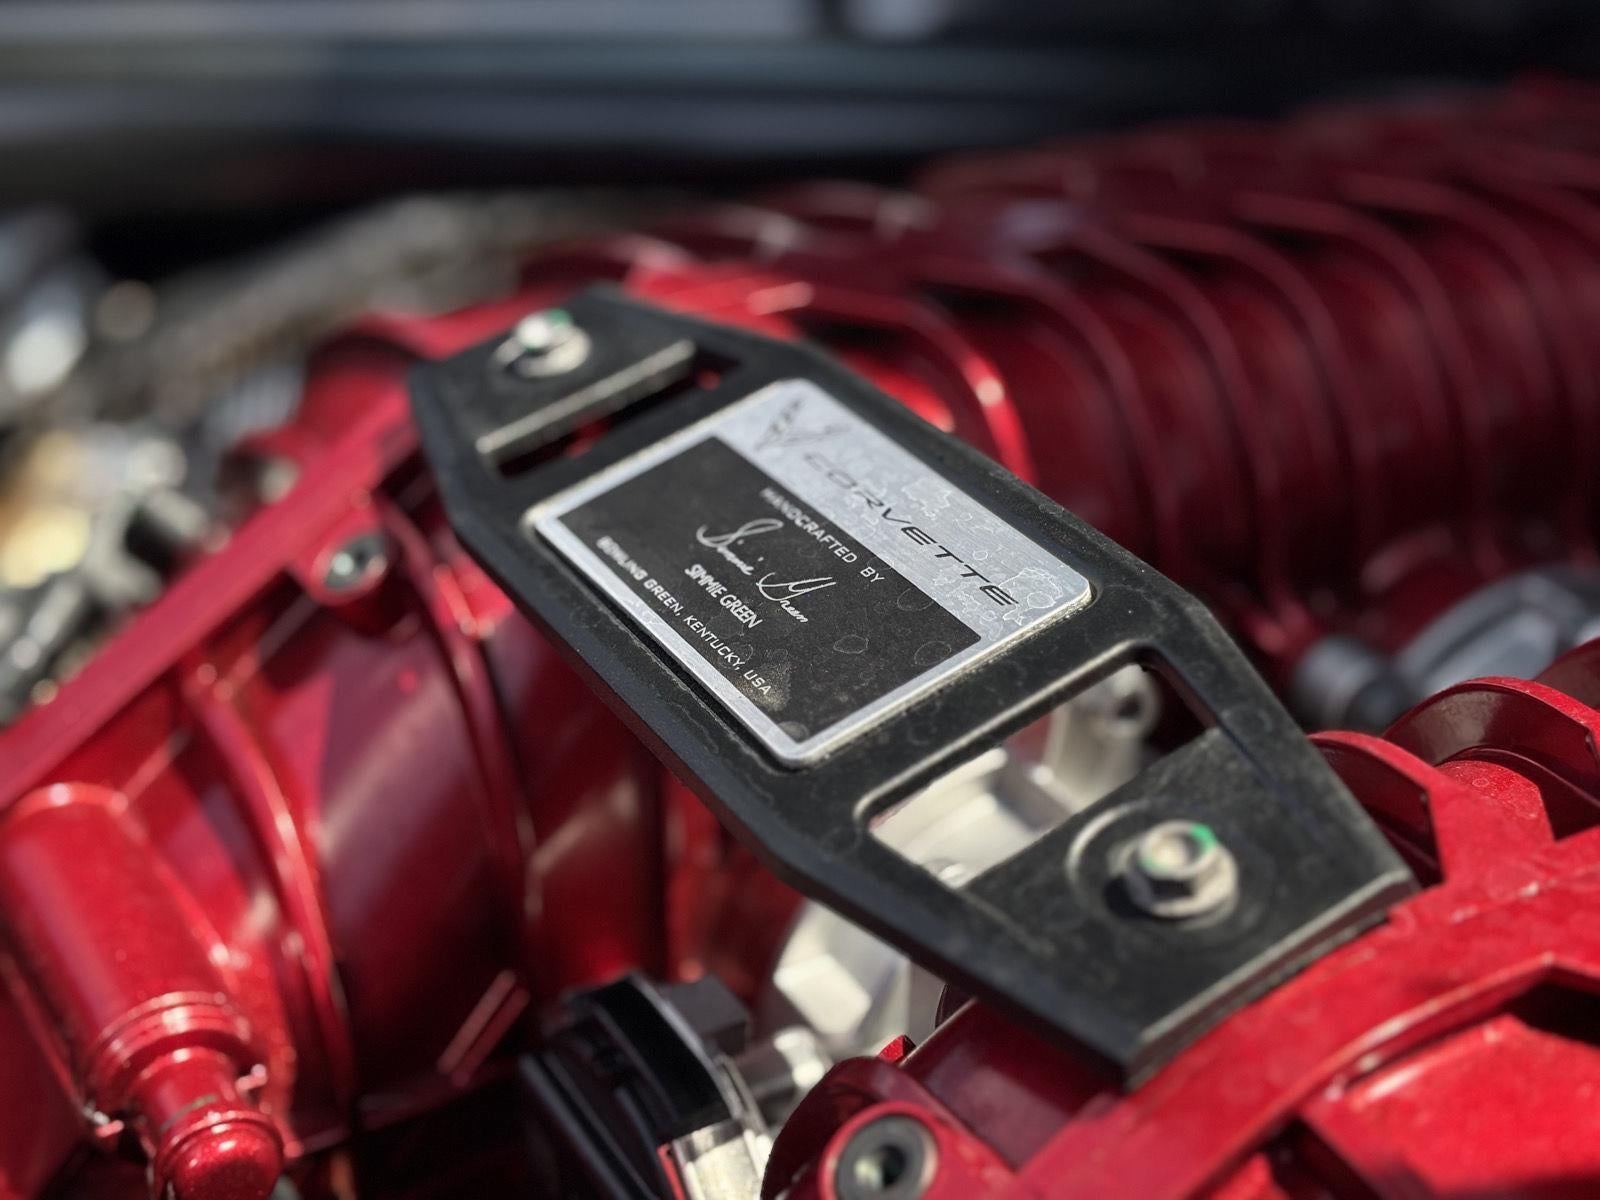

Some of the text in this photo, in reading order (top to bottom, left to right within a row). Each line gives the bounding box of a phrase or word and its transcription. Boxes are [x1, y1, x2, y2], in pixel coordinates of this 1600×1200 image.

[804, 453, 1019, 607] CORVETTE
[684, 563, 763, 629] SIMMIE GREEN
[860, 566, 885, 583] BY
[743, 669, 772, 695] USA
